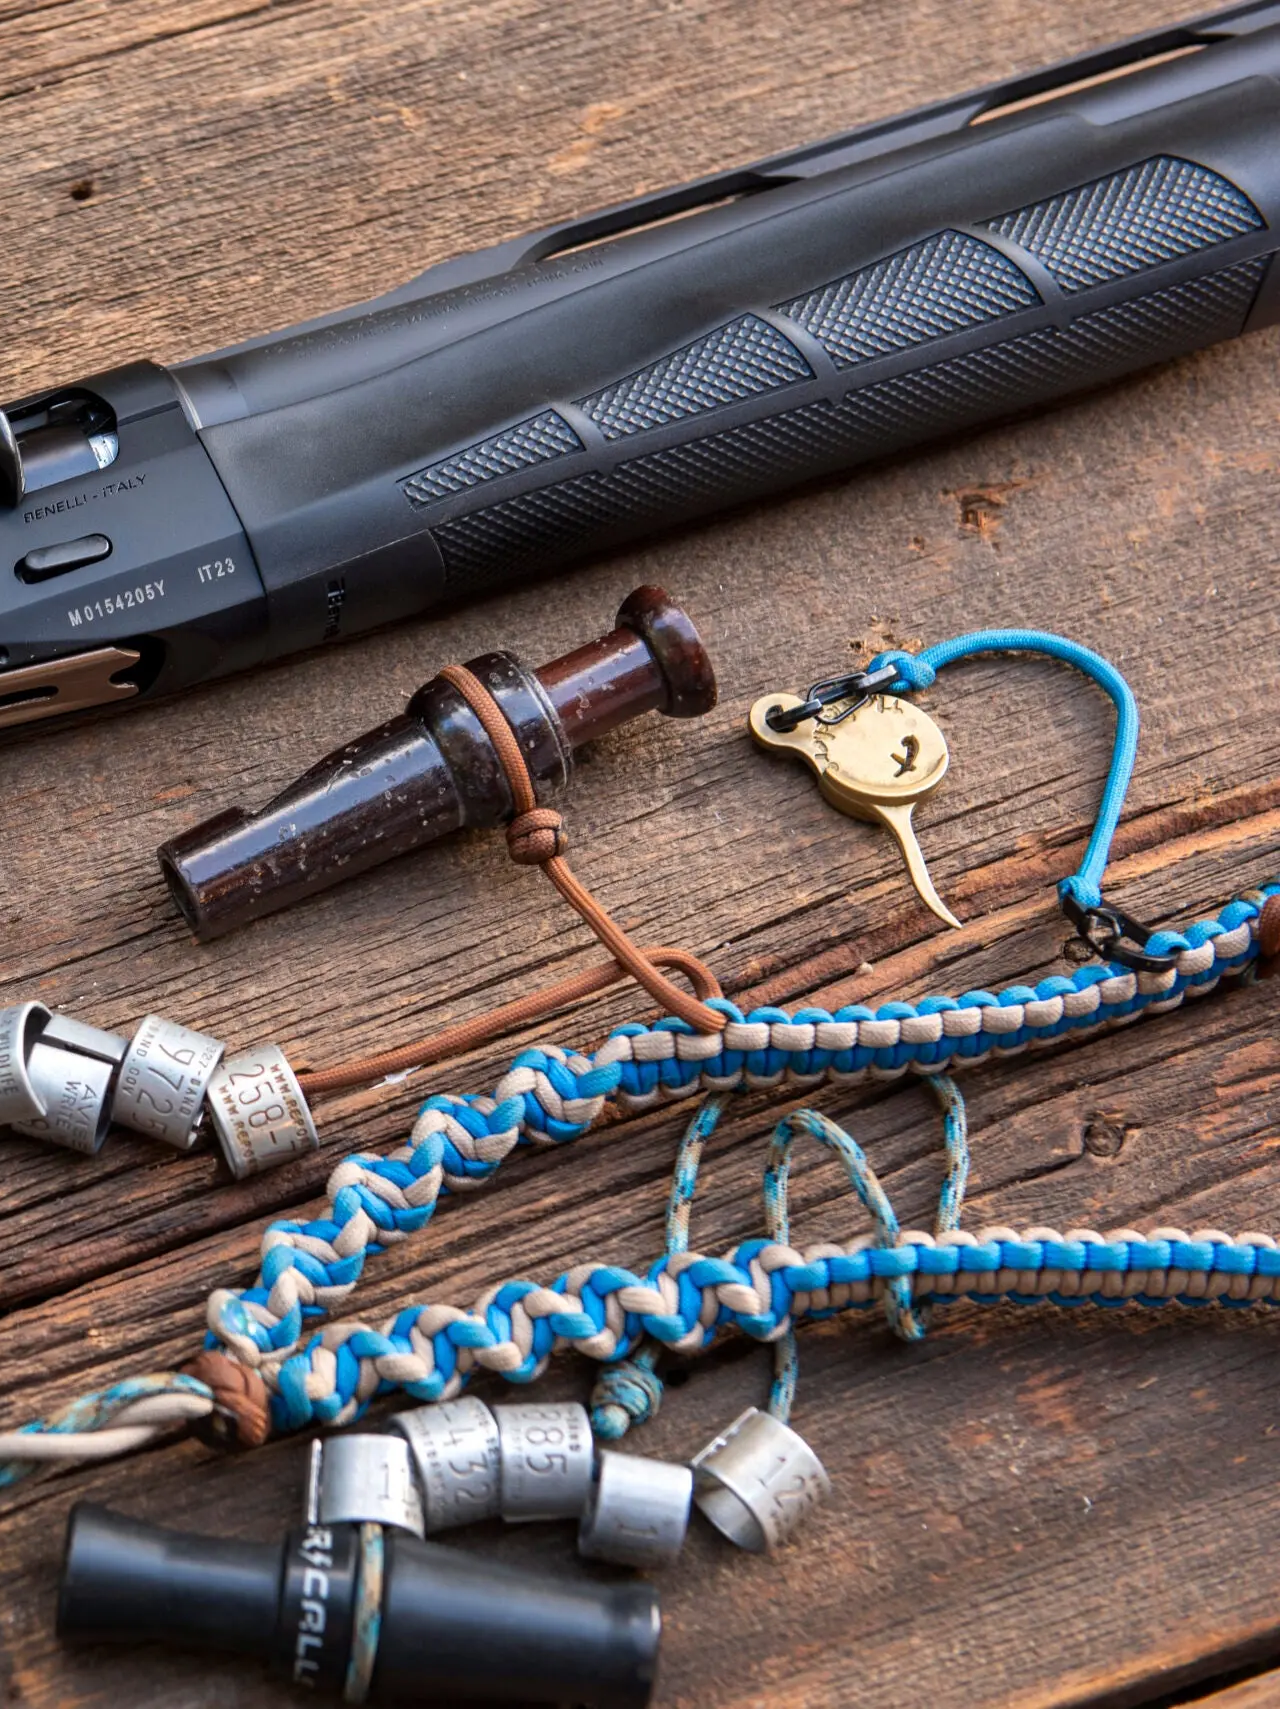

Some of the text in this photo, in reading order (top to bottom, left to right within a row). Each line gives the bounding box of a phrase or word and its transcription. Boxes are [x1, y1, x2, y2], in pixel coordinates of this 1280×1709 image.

[23, 493, 88, 523] BENELLI
[197, 556, 237, 584] IT23
[67, 578, 167, 627] M0154205Y
